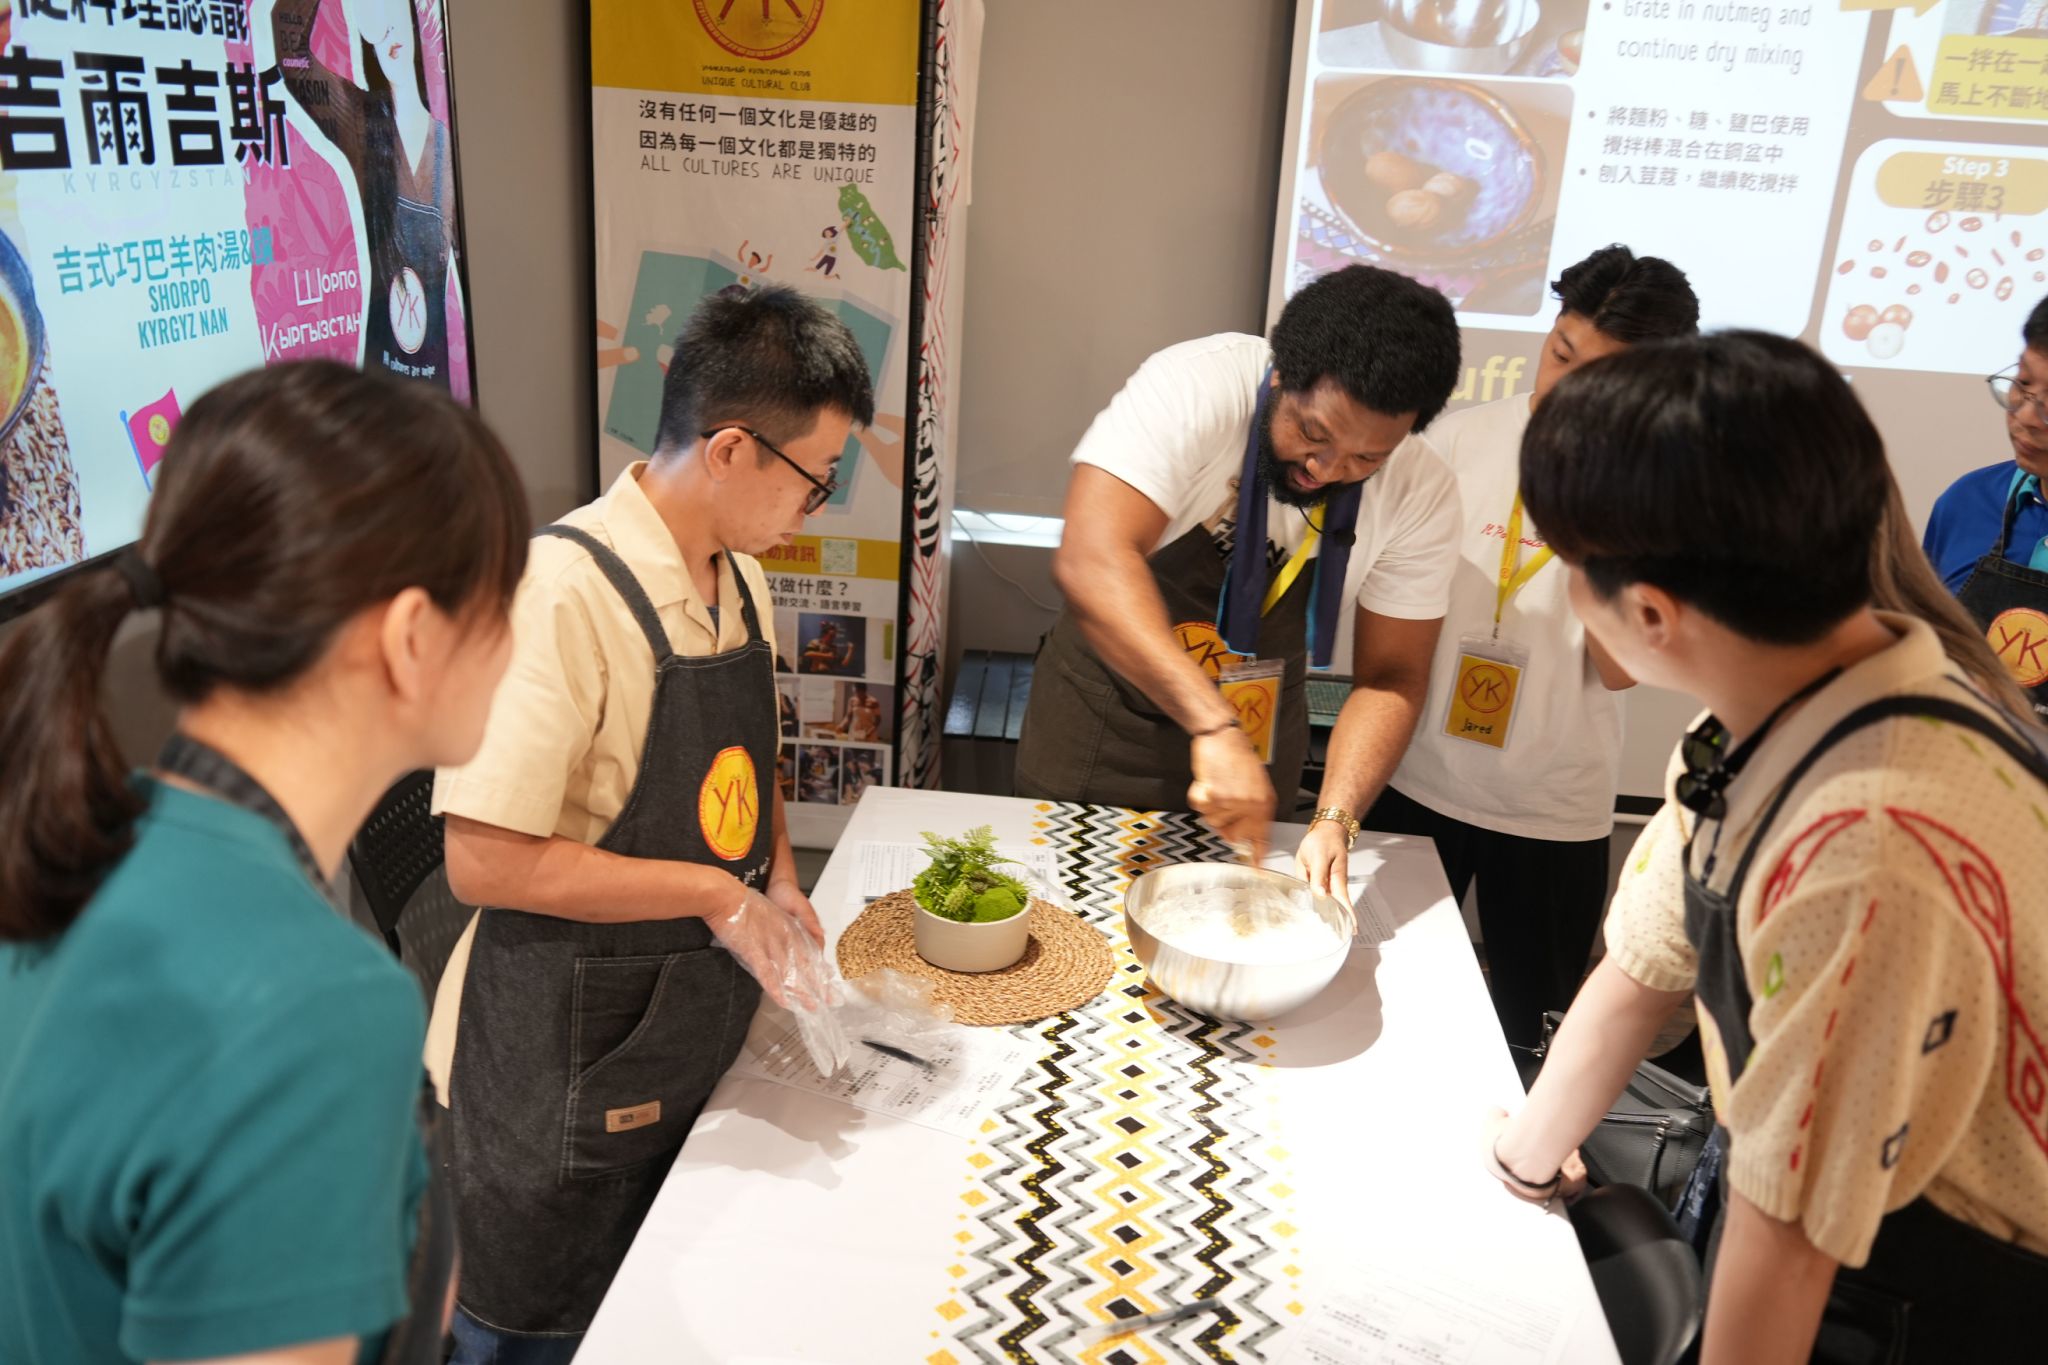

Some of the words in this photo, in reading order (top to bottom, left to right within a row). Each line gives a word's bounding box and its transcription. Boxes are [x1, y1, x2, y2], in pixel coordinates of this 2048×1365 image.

[1678, 1, 1695, 20] in
[1702, 3, 1771, 33] nutmeg
[1778, 6, 1812, 26] and
[1617, 38, 1698, 61] continue
[1706, 41, 1737, 73] dry
[1745, 43, 1802, 75] mixing
[702, 76, 736, 87] UNIQUE
[741, 78, 785, 90] CULTURAL
[790, 81, 811, 91] CLUB
[0, 45, 292, 171] 吉爾吉斯
[640, 99, 877, 132] 沒有任何一個文化是優越的
[640, 130, 876, 163] 因為每一個文化都是獨特的
[62, 167, 252, 194] KYRGYZSTAN
[640, 154, 671, 172] ALL
[683, 157, 760, 178] CULTURES
[772, 163, 802, 180] ARE
[814, 166, 875, 184] UNIQUE
[1942, 156, 1991, 180] Step
[1994, 159, 2010, 177] 3
[1922, 179, 2006, 211] 步驟3
[148, 278, 211, 312] SHORPO
[138, 313, 197, 349] KYRGYZ
[199, 307, 229, 336] NAN
[1470, 676, 1502, 703] YK
[713, 776, 753, 834] YK
